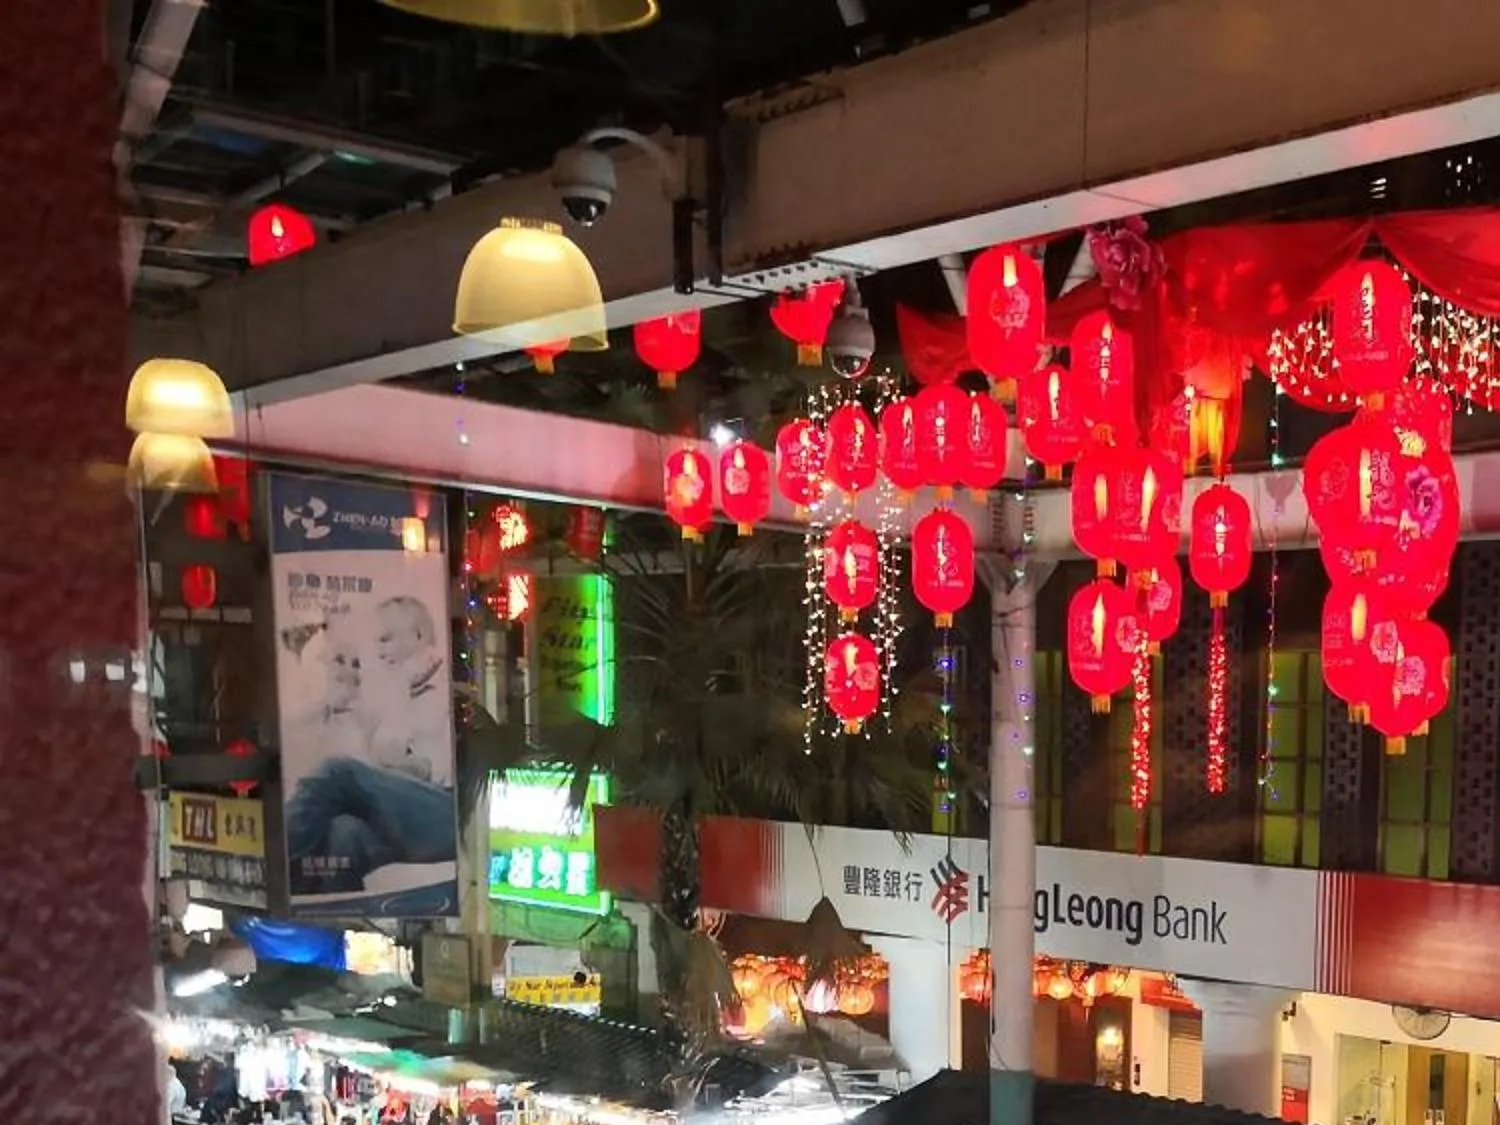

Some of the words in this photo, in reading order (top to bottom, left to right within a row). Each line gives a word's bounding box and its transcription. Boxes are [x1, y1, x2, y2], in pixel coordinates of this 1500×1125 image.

[843, 864, 923, 903] 豐隆銀行
[1152, 894, 1228, 945] Bank
